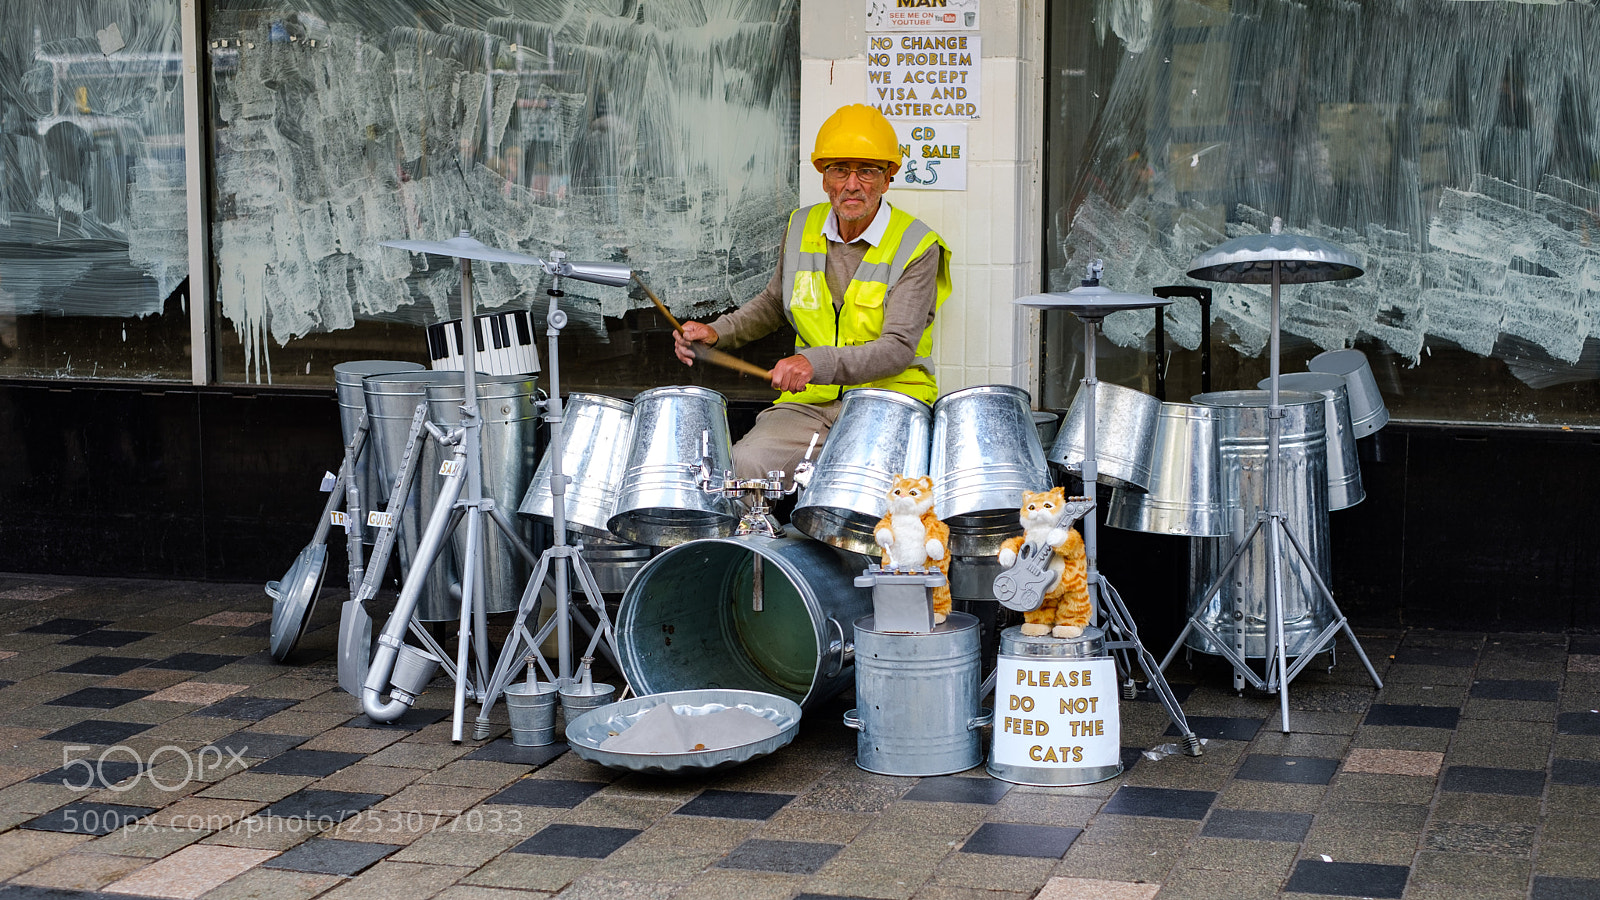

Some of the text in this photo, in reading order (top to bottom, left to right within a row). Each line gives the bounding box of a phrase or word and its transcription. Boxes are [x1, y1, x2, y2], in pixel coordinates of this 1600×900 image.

[871, 36, 968, 50] NO CHANGE
[868, 53, 972, 67] NO PROBLEM
[868, 70, 968, 84] WE ACCEPT
[877, 87, 967, 100] VISA AND
[911, 126, 936, 141] CD
[898, 144, 960, 159] N SALE
[904, 159, 941, 185] £5
[1016, 669, 1092, 687] PLEASE
[1009, 694, 1099, 714] DO NOT
[1004, 716, 1104, 737] FEED THE
[1029, 745, 1084, 763] CATS
